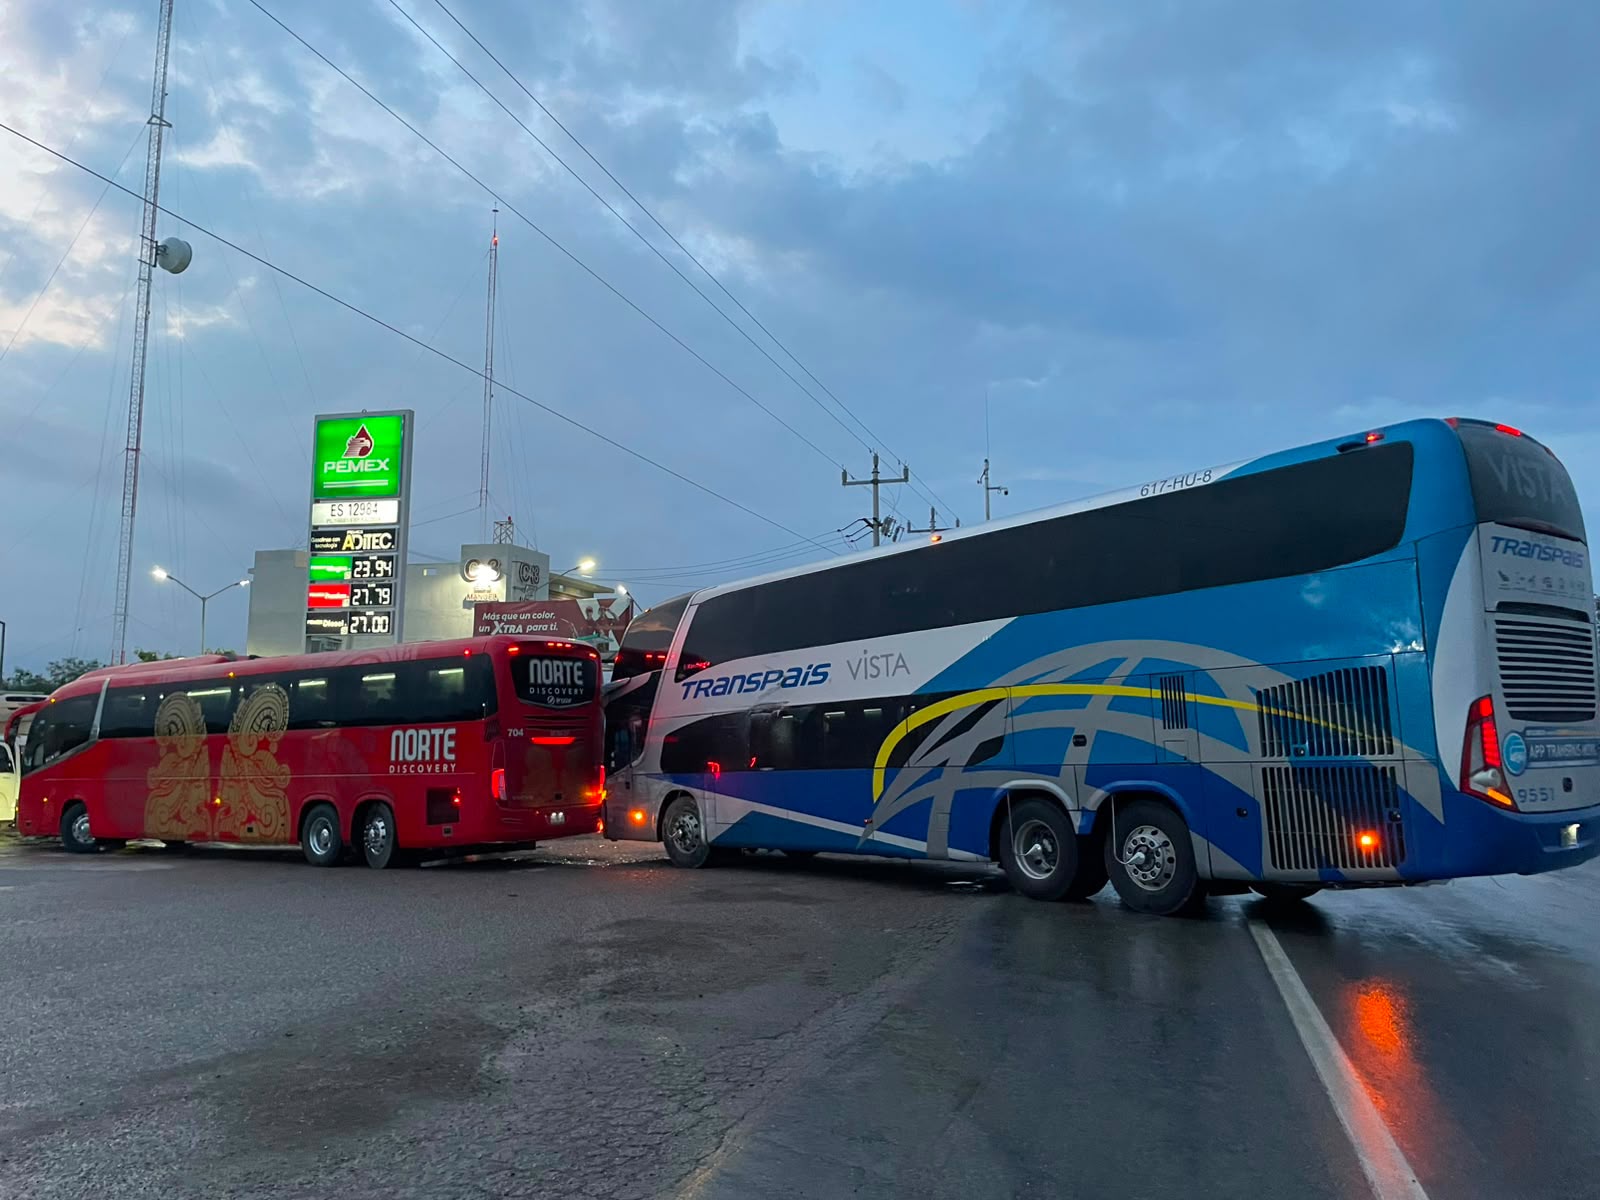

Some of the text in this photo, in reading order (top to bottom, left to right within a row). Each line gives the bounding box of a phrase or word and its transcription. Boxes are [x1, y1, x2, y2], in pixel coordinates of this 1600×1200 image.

[323, 458, 389, 474] PEMEX
[1140, 469, 1213, 497] 617-HU-8
[330, 504, 344, 517] ES
[353, 560, 392, 577] 23.94
[352, 588, 391, 605] 27.79
[350, 615, 389, 633] 27.00
[482, 611, 500, 620] Más
[501, 613, 518, 621] que
[532, 611, 556, 620] color,
[491, 621, 523, 635] XTRA
[526, 625, 548, 633] para
[549, 623, 559, 632] ti.
[529, 659, 584, 685] NORTE
[529, 687, 584, 695] DISCOVERY
[507, 728, 524, 737] 704
[390, 728, 457, 762] NORTE
[389, 763, 457, 774] DISCOVERY
